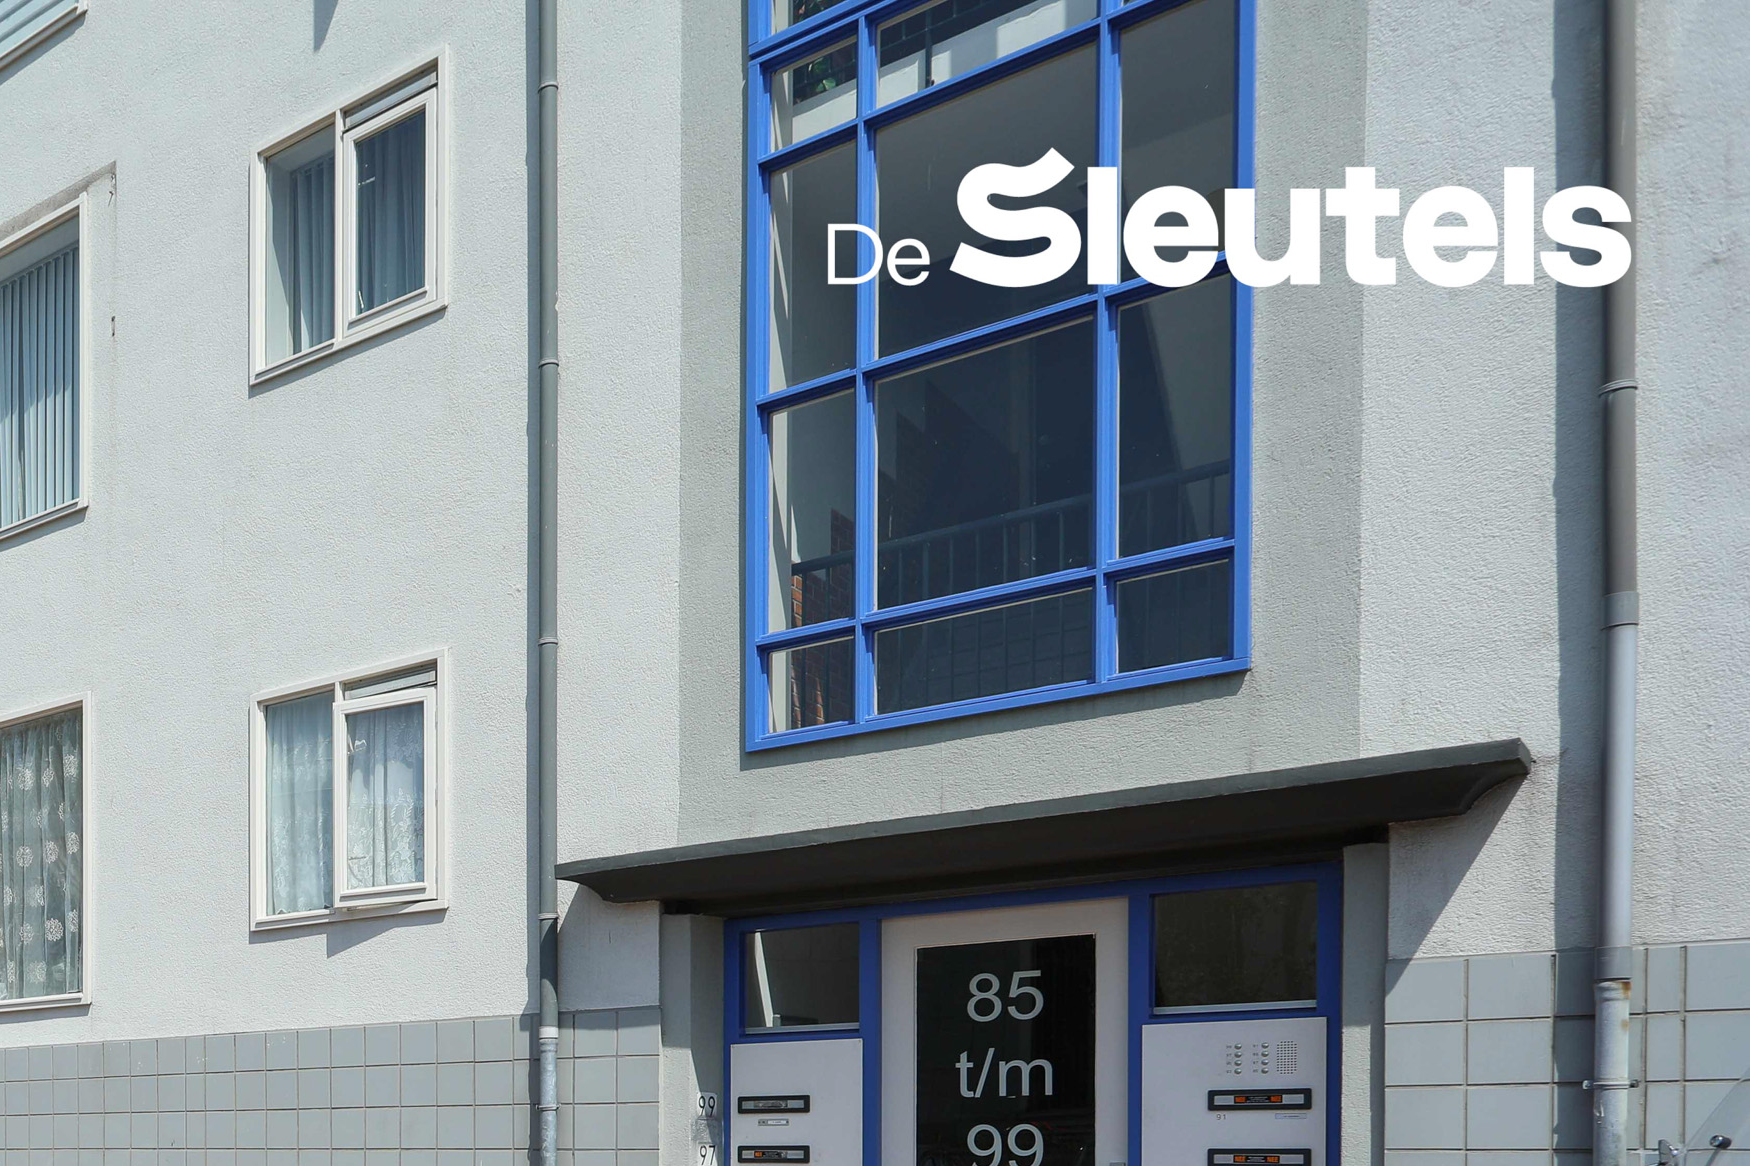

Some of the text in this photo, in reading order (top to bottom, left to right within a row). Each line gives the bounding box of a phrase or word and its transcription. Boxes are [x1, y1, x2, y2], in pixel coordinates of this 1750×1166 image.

[966, 970, 1044, 1022] 85
[955, 1048, 1053, 1098] t/m
[699, 1095, 716, 1116] 99
[699, 1145, 716, 1165] 97
